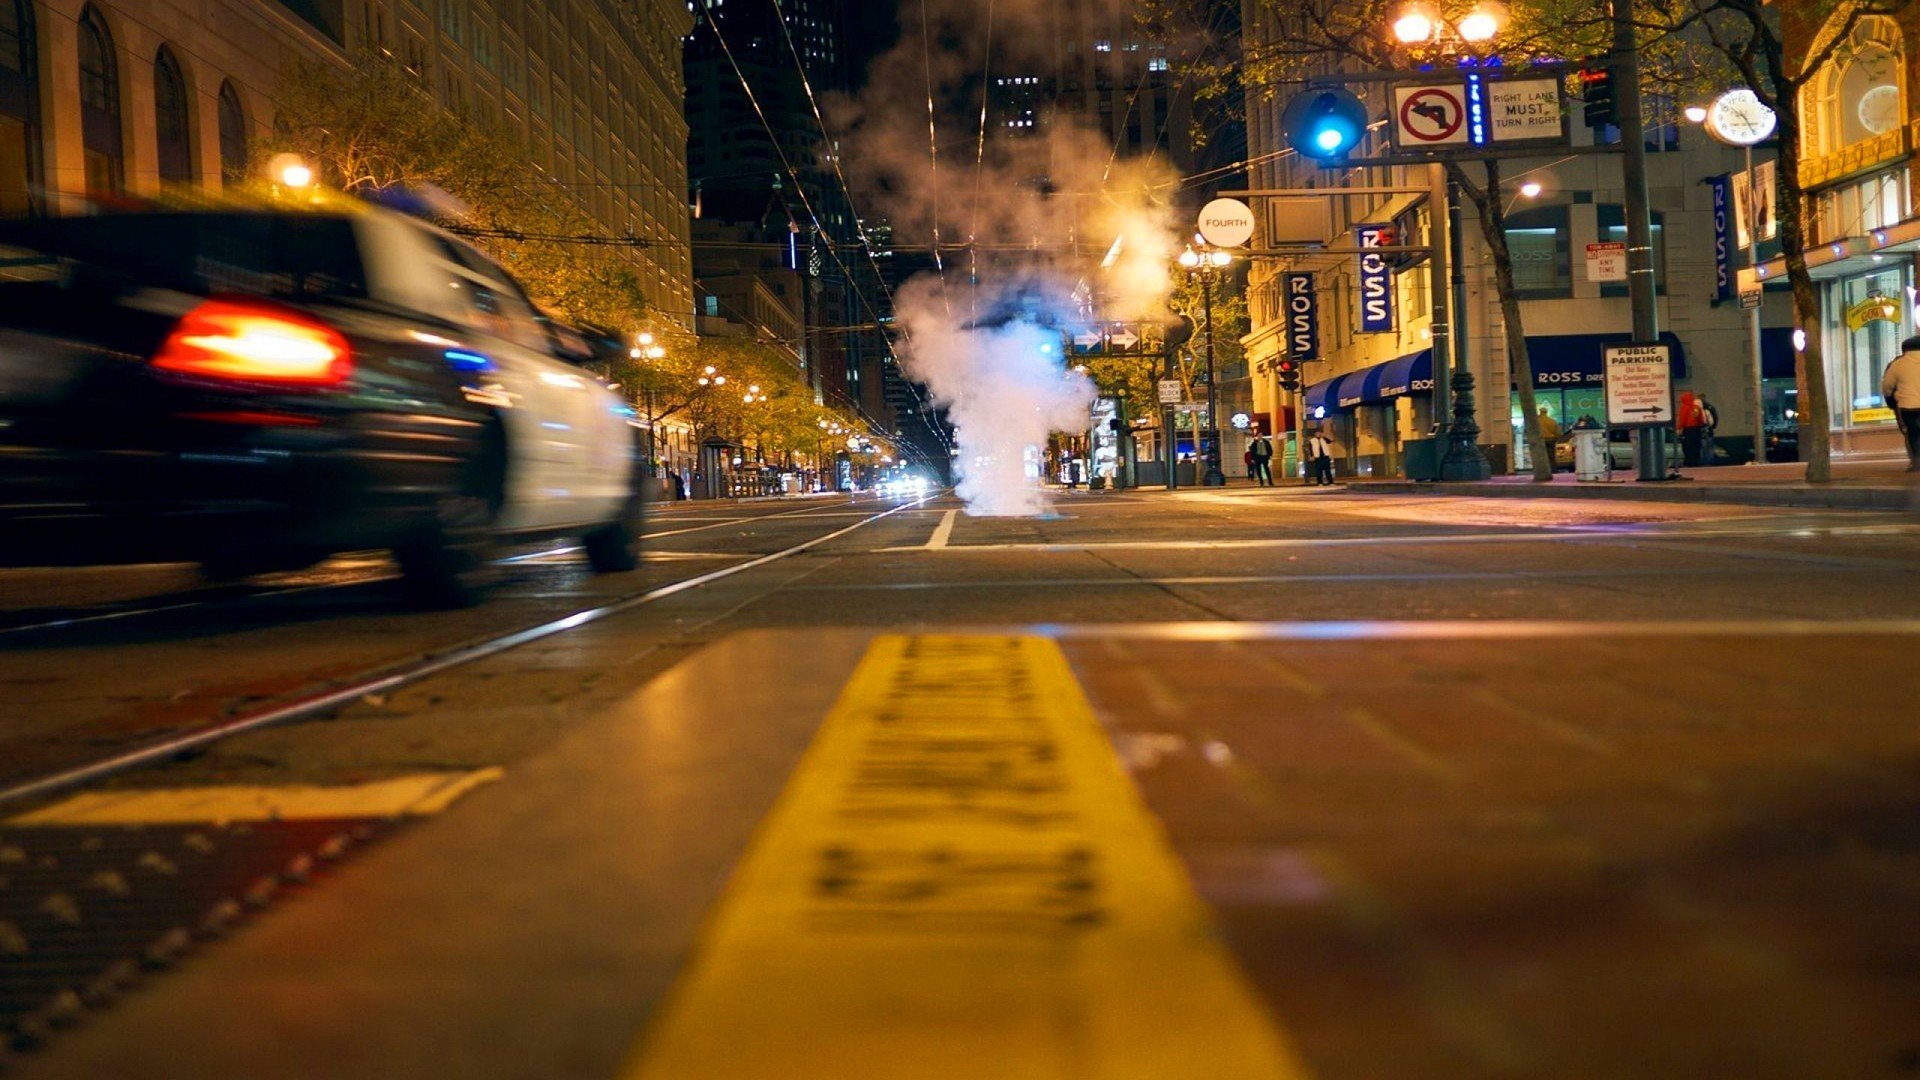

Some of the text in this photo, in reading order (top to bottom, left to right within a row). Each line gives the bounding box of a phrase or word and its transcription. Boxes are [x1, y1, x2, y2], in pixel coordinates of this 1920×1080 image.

[1493, 92, 1554, 102] RIGHT LANE
[1506, 103, 1543, 115] MUST
[1496, 116, 1557, 127] TURN RIGHT
[1206, 219, 1247, 227] FOURTH
[1715, 183, 1727, 286] ROSS
[1362, 230, 1386, 321] ROSS
[1291, 277, 1312, 352] ROSS
[1617, 347, 1657, 356] PUBLIC
[1611, 356, 1664, 365] PARKING
[1538, 372, 1581, 383] ROSS
